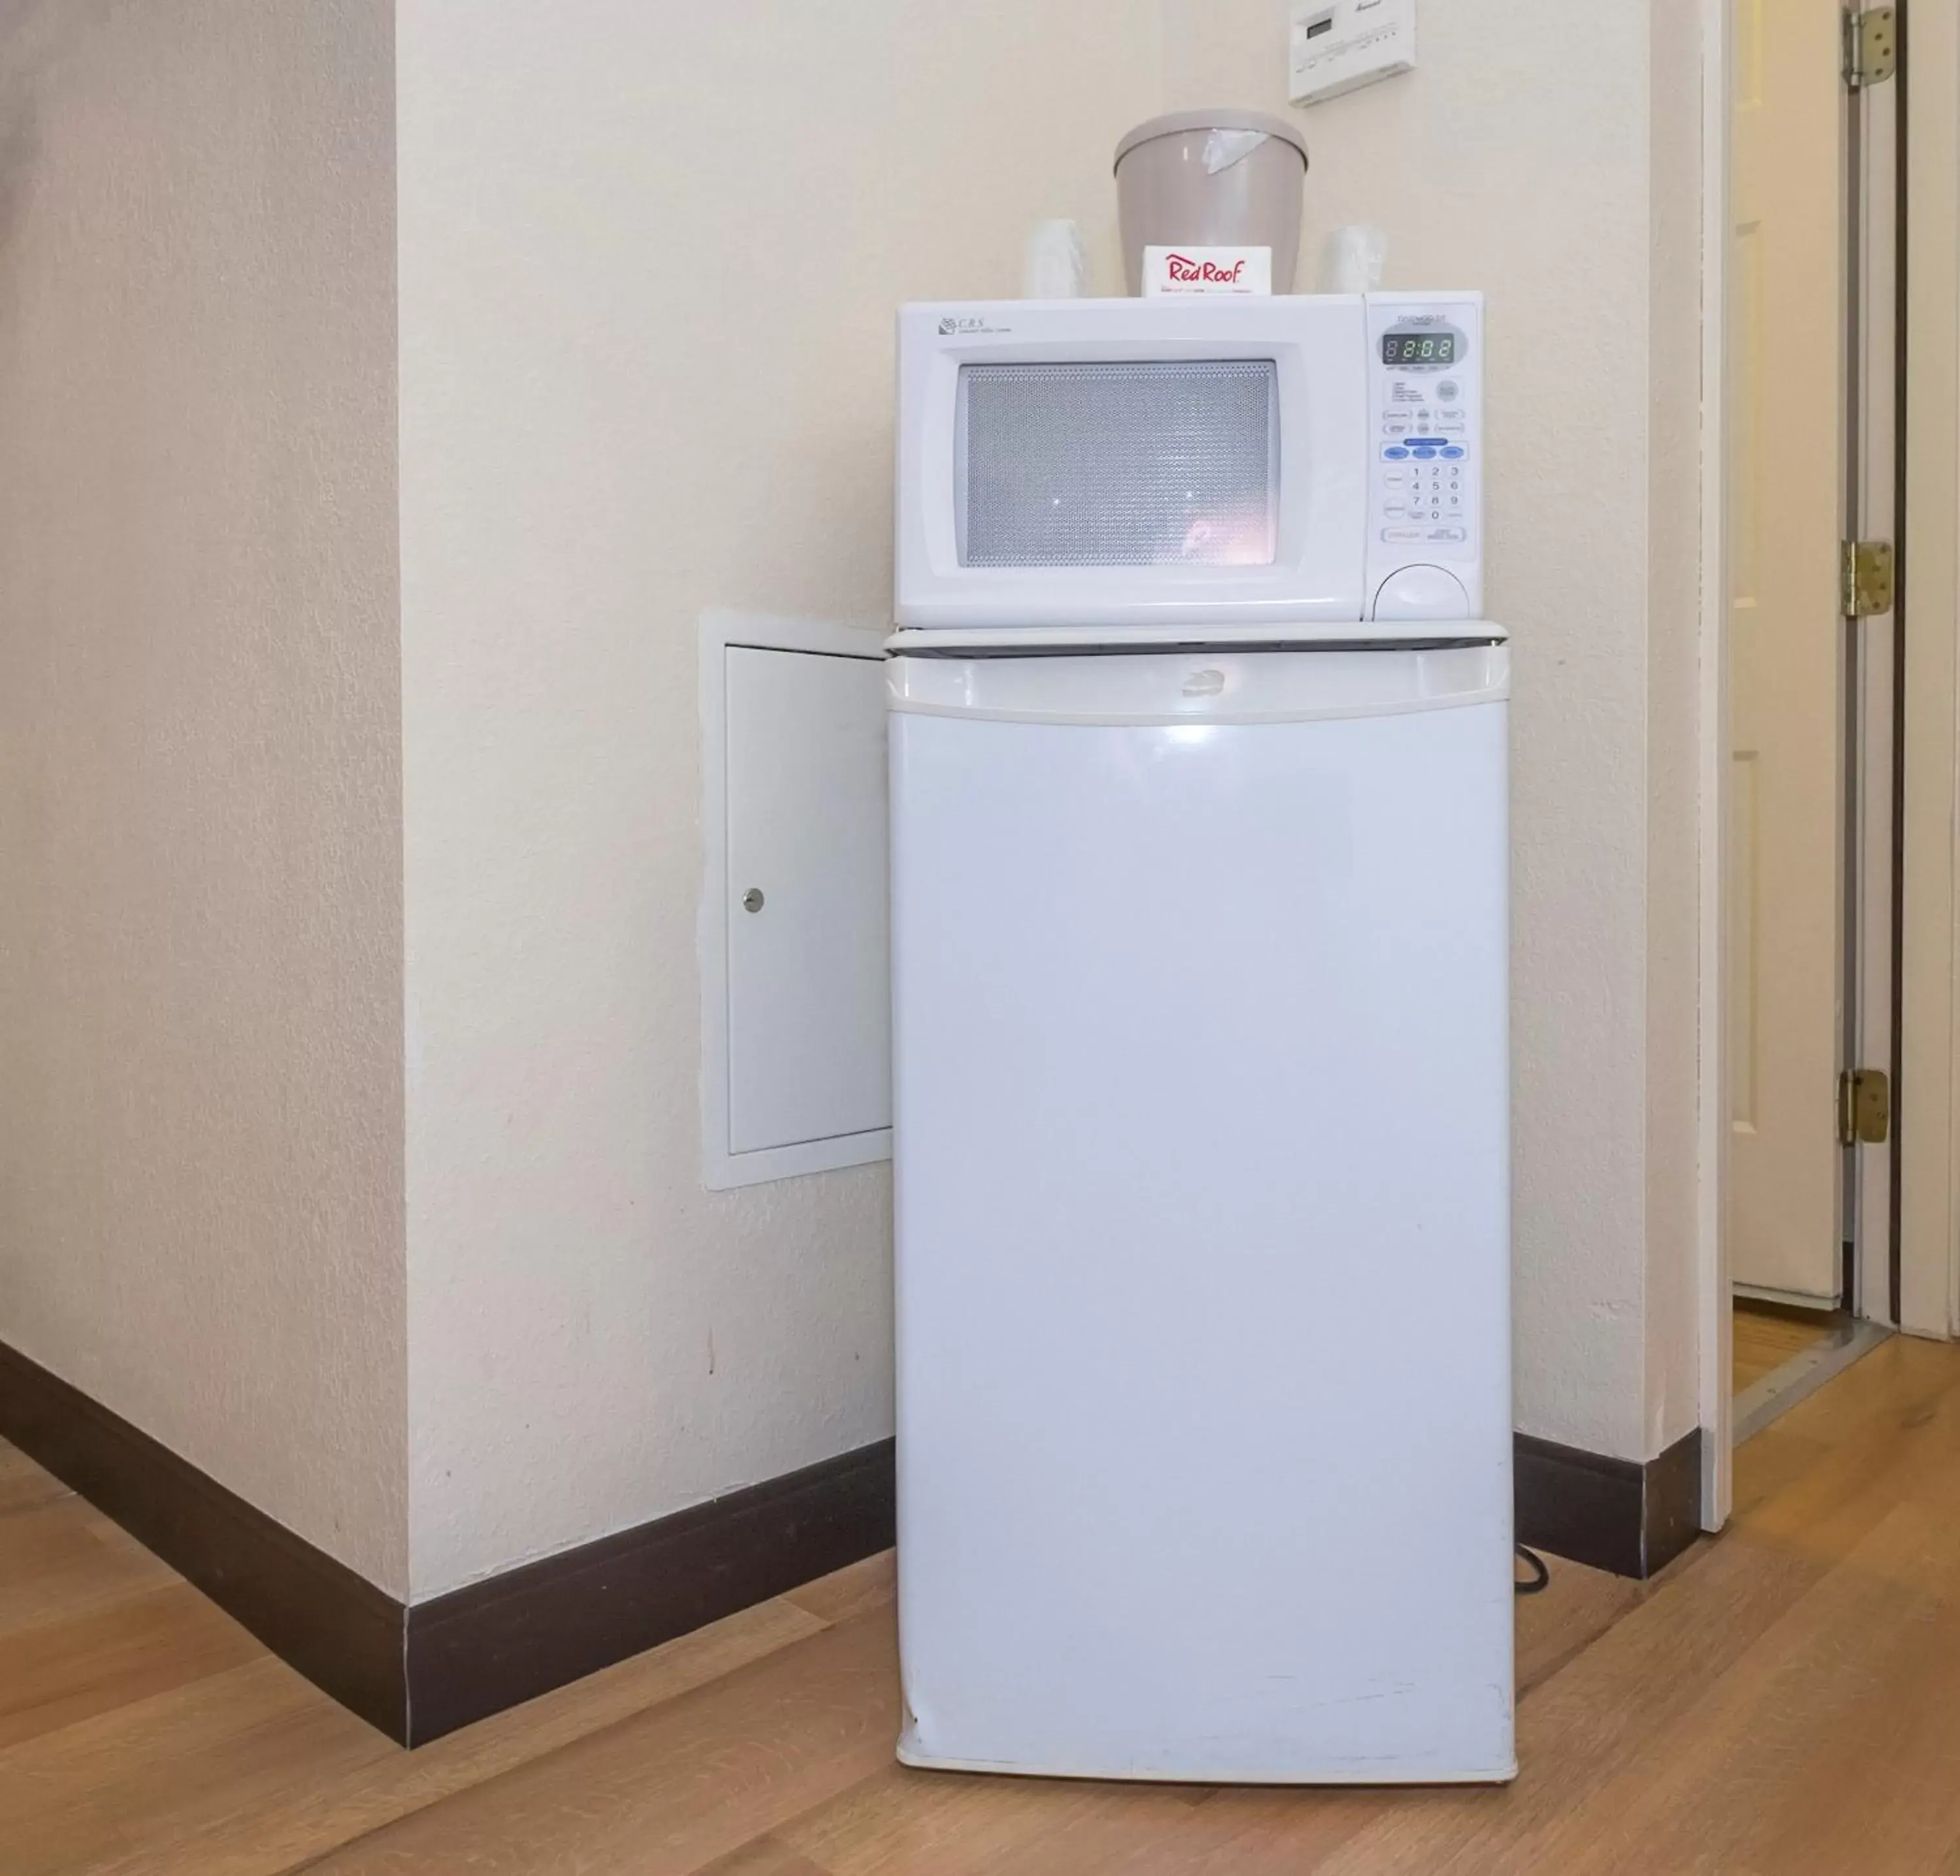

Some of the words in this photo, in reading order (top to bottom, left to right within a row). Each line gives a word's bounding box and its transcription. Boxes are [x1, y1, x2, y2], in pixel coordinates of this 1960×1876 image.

[1169, 261, 1201, 282] Red
[1203, 260, 1245, 283] Roof
[1432, 467, 1439, 476] 2
[1451, 467, 1458, 476] 3
[1432, 481, 1439, 490] 5
[1450, 481, 1458, 490] 6
[1413, 496, 1420, 505] 7
[1431, 496, 1439, 505] 8
[1450, 496, 1458, 504] 9
[1431, 511, 1439, 519] 0
